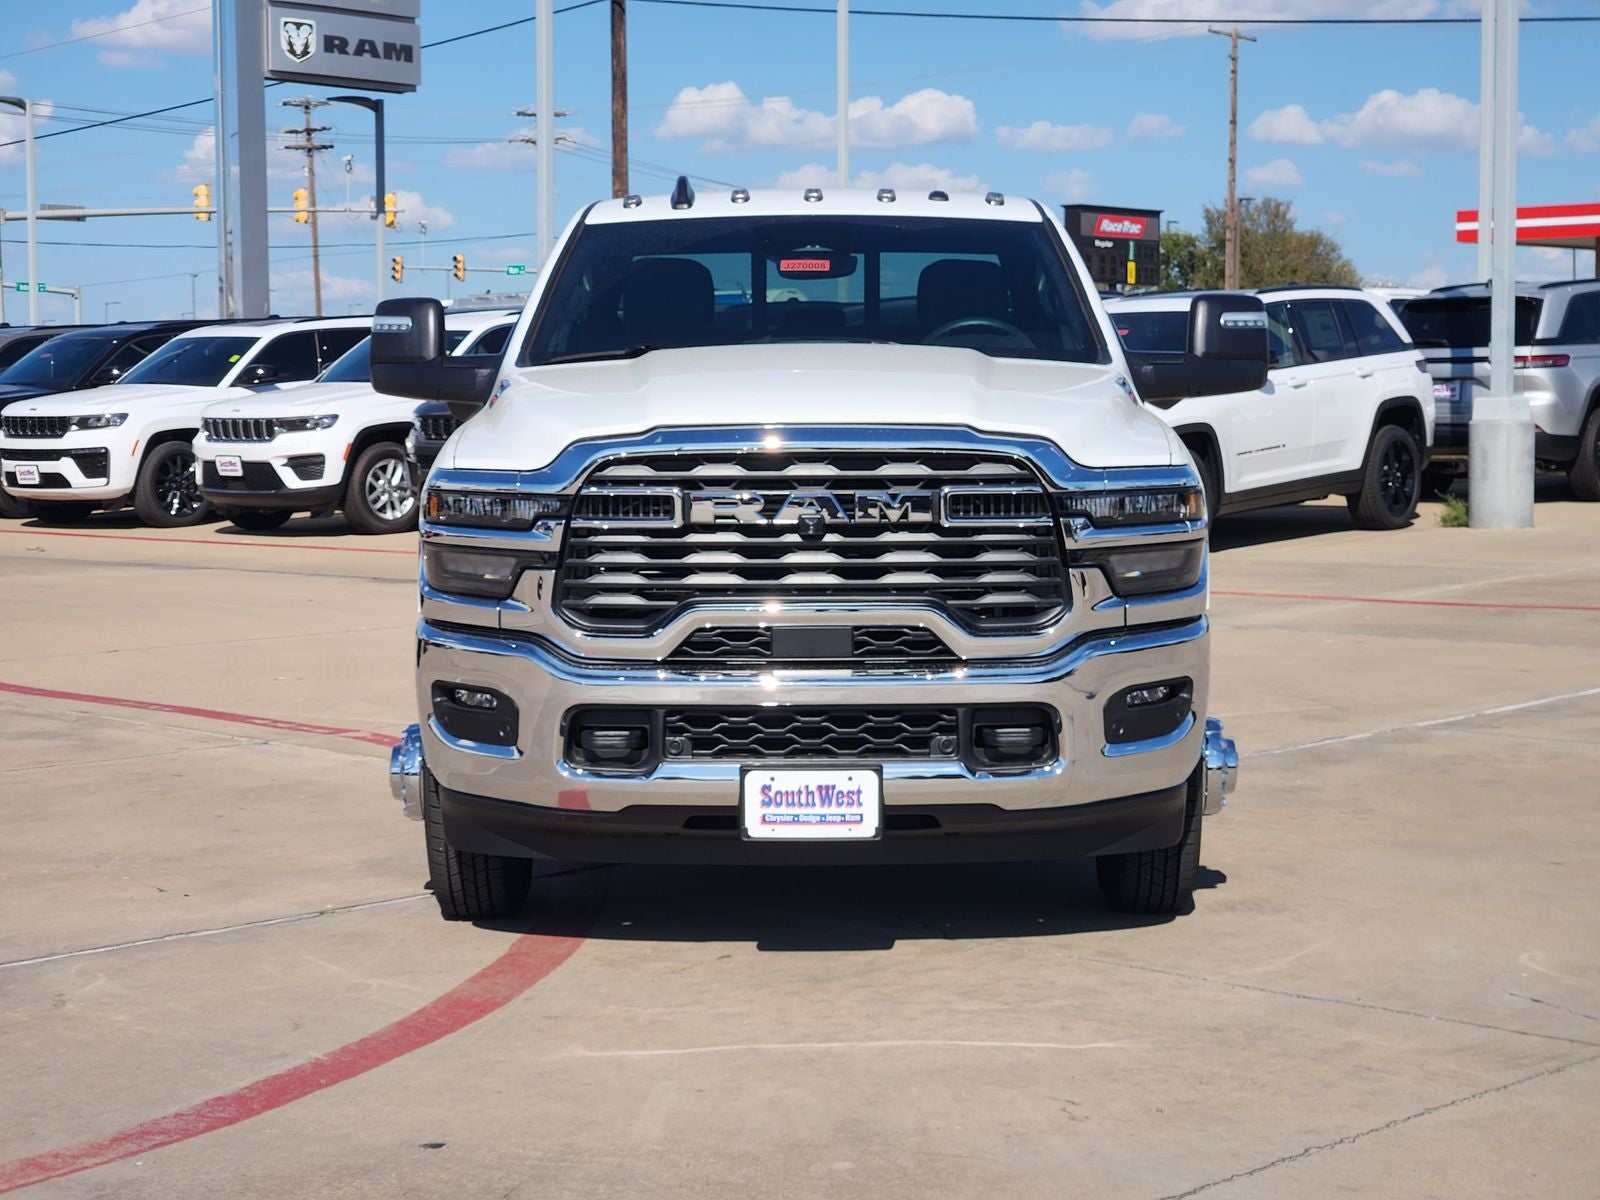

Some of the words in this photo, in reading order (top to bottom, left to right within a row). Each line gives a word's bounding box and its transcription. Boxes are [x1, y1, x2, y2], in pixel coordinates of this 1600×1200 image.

[323, 34, 413, 63] RAM
[1099, 219, 1142, 234] RaceTrac
[690, 491, 933, 525] RAM
[765, 814, 794, 823] Chrysler
[799, 814, 821, 823] Dodge
[845, 814, 861, 822] Ram
